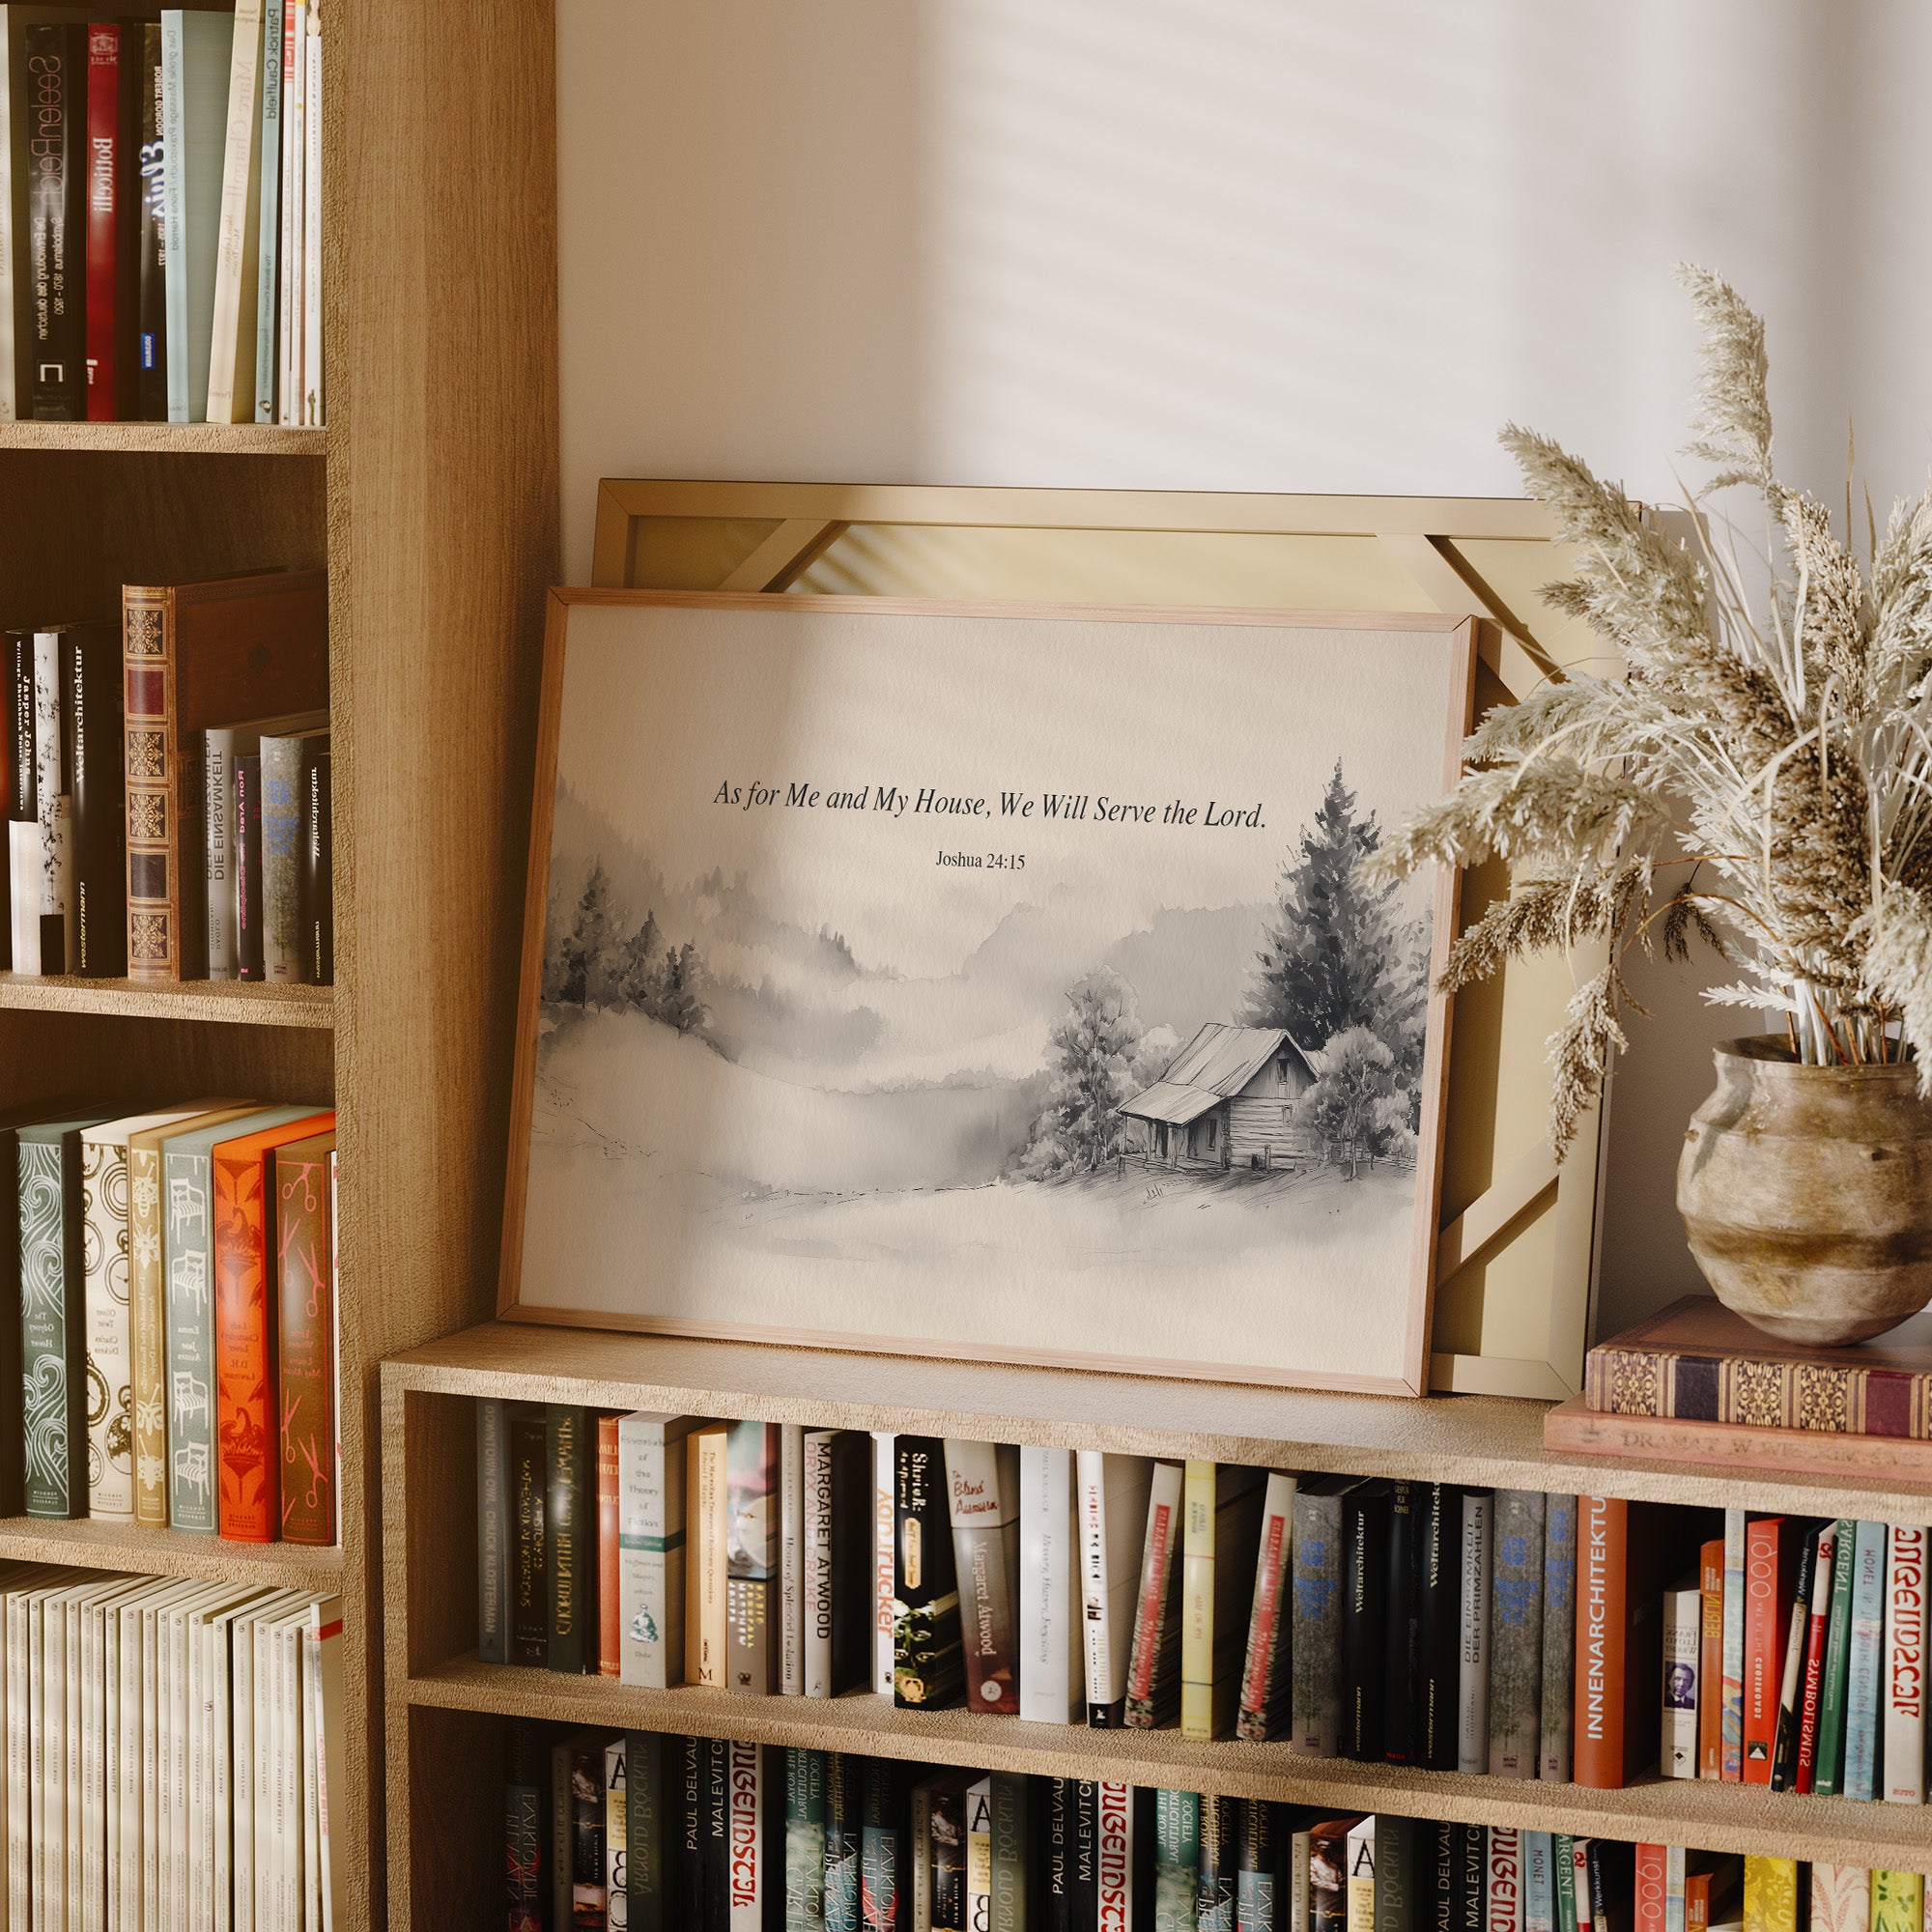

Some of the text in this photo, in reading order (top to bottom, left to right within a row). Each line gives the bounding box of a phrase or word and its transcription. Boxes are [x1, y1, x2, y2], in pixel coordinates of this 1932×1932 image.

[73, 645, 84, 783] Weltarchitektur
[23, 731, 32, 776] Johns
[713, 780, 1267, 829] As for Me and My House, We Will Serve the Lord.
[936, 850, 1026, 869] Joshua 24:15
[629, 1485, 659, 1497] Theory
[806, 1440, 817, 1612] ORYX AND CRAKE
[816, 1441, 832, 1640] MARGARET ATWOOD
[1354, 1510, 1365, 1614] Weltarchitektur
[1472, 1506, 1484, 1664] DER PRIMZAHLEN
[971, 1541, 998, 1656] Margaret Atwood
[1463, 1520, 1474, 1663] DIE EINSAMKEIT
[686, 1807, 697, 1851] PAUL
[1052, 1851, 1065, 1894] PAUL
[1351, 1838, 1375, 1879] A
[1533, 1849, 1545, 1886] MONET
[1574, 1851, 1585, 1868] 2
[1592, 1860, 1604, 1908] Werkkunst
[1635, 1856, 1662, 1919] 1900
